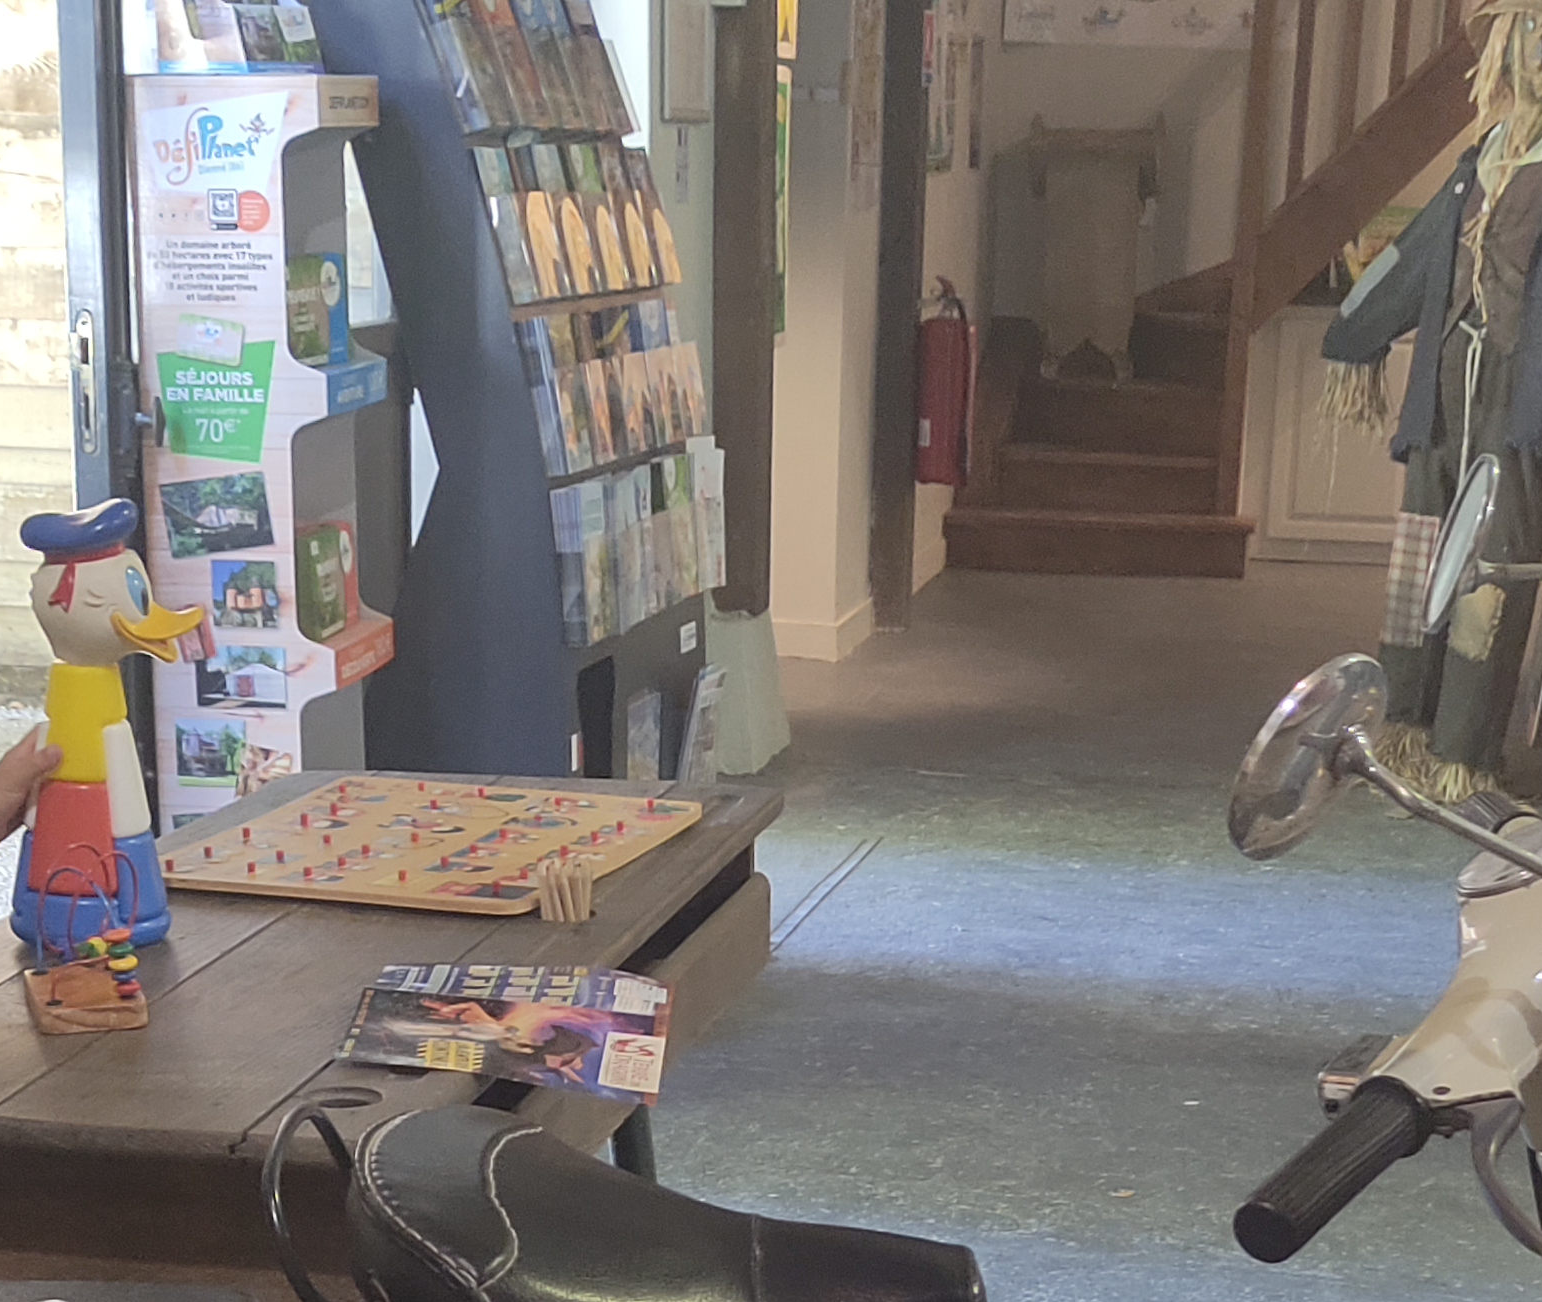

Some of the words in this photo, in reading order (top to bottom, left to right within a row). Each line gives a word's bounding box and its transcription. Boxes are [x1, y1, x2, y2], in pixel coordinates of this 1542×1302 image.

[180, 240, 219, 249] domaine
[212, 252, 234, 260] avec
[236, 250, 246, 259] 17
[248, 252, 273, 263] types
[175, 367, 254, 386] SÉJOURS
[166, 386, 190, 402] EN
[192, 387, 265, 403] FAMILLE
